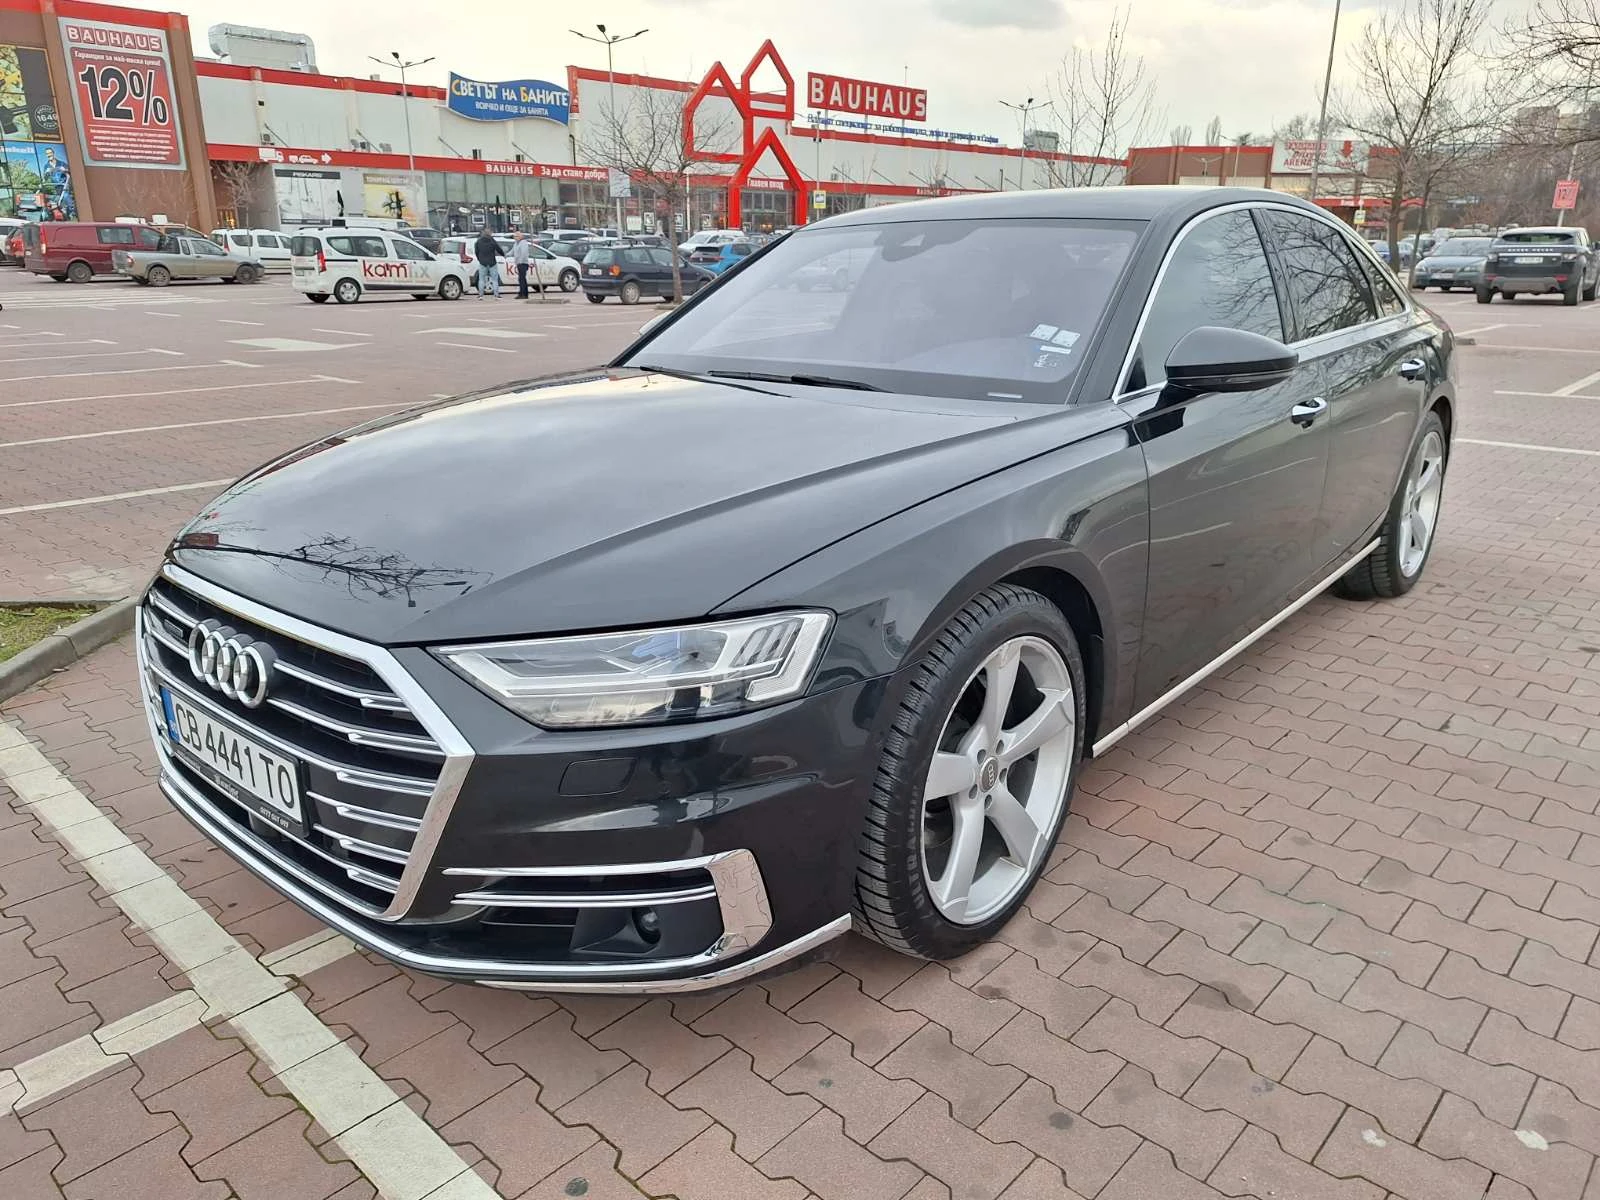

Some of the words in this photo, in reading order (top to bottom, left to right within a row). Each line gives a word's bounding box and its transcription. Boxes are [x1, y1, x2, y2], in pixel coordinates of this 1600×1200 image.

[67, 27, 161, 50] BAUHAUS
[79, 64, 168, 126] 12%
[451, 79, 498, 99] СВЕТЪТ
[502, 88, 517, 101] НА
[520, 87, 569, 106] БАНИТЕ
[811, 77, 926, 117] BAUHAUS
[486, 164, 533, 175] BAUHAUS
[541, 166, 551, 176] За
[552, 168, 561, 178] да
[563, 169, 583, 178] стане
[175, 702, 202, 752] CB
[205, 722, 256, 788] 4441
[259, 751, 295, 810] TO
